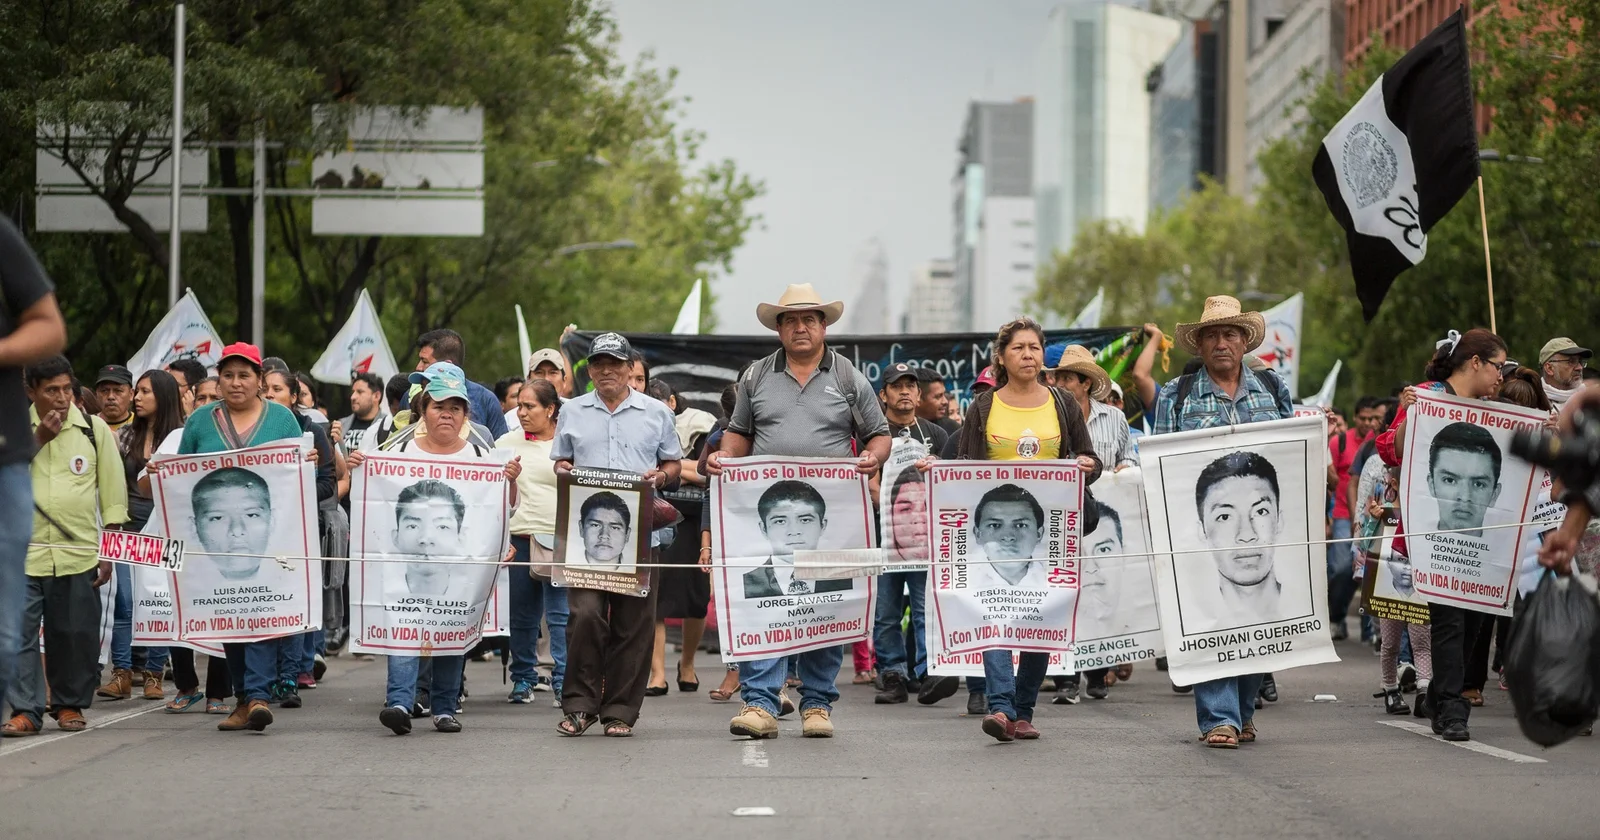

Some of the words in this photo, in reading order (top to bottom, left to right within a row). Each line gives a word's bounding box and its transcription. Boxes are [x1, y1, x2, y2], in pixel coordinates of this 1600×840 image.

[1418, 401, 1445, 418] ¡Vivo
[1449, 408, 1462, 420] se
[1466, 409, 1477, 424] lo
[162, 461, 198, 479] ¡Vivo
[201, 459, 217, 471] se
[220, 456, 233, 468] lo
[237, 451, 297, 467] llevaron!
[369, 460, 405, 476] ¡Vivo
[410, 467, 425, 477] se
[429, 465, 442, 478] lo
[446, 466, 505, 482] llevaron!
[570, 469, 609, 479] Christian
[612, 472, 641, 482] Tomás
[723, 468, 758, 483] ¡Vivo
[762, 468, 777, 480] se
[781, 466, 795, 478] lo
[800, 466, 858, 480] llevaron!
[934, 468, 972, 484] ¡Vivo
[976, 469, 992, 480] se
[996, 468, 1009, 480] lo
[1014, 468, 1077, 482] llevaron!
[577, 477, 601, 485] Colón
[602, 480, 633, 488] Garnica
[939, 509, 968, 528] 43!
[1050, 509, 1063, 538] Dónde
[1067, 511, 1078, 532] Nos
[954, 529, 967, 555] están
[1425, 534, 1455, 545] CÉSAR
[1456, 539, 1490, 551] MANUEL
[100, 532, 123, 559] NOS
[124, 535, 163, 564] FALTAN
[162, 539, 184, 569] 43!
[1066, 535, 1078, 568] faltan
[1433, 544, 1479, 559] GONZÁLEZ
[1430, 553, 1482, 568] HERNÁNDEZ
[562, 569, 582, 578] Vivos
[1430, 562, 1451, 572] EDAD
[1462, 568, 1481, 577] AÑOS
[565, 576, 585, 584] Vivos
[586, 577, 598, 585] los
[599, 579, 636, 589] queremos
[940, 567, 950, 590] Nos
[1048, 568, 1077, 589] 43!
[1429, 572, 1449, 589] VIDA
[1451, 576, 1459, 591] lo
[1460, 580, 1505, 598] queremos!
[214, 587, 236, 596] LUIS
[238, 586, 272, 594] ÁNGEL
[973, 588, 1007, 598] JESÚS
[1008, 590, 1049, 598] JOVANY
[193, 597, 250, 606] FRANCISCO
[397, 597, 433, 605] JOSÉ
[757, 599, 794, 608] JORGE
[796, 594, 844, 606] ÁLVAREZ
[981, 597, 1043, 605] RODRÍGUEZ
[1369, 598, 1387, 606] Vivos
[384, 605, 422, 613] LUNA
[426, 607, 476, 616] TORRES
[788, 607, 815, 617] NAVA
[988, 606, 1040, 614] TLATEMPA
[1371, 604, 1388, 612] Vivos
[1401, 610, 1430, 620] queremo
[185, 619, 207, 634] ¡Con
[210, 617, 234, 631] VIDA
[236, 616, 245, 630] lo
[247, 613, 303, 631] queremos!
[442, 619, 467, 627] AÑOS
[768, 621, 795, 629] EDAD
[810, 615, 835, 623] AÑOS
[1022, 614, 1044, 622] AÑOS
[1387, 612, 1405, 621] lucha
[1406, 616, 1424, 624] sigue
[147, 620, 169, 632] VIDA
[367, 625, 388, 640] ¡Con
[391, 627, 418, 640] VIDA
[421, 628, 431, 641] lo
[736, 632, 761, 648] ¡Con
[764, 629, 792, 644] VIDA
[795, 627, 803, 639] lo
[806, 618, 862, 639] queremos!
[950, 630, 972, 647] ¡Con
[974, 625, 1000, 640] VIDA
[1003, 624, 1013, 638] lo
[1015, 626, 1068, 642] queremos!
[1179, 631, 1250, 652] JHOSIVANI
[1253, 619, 1322, 641] GUERRERO
[1098, 638, 1139, 652] ÁNGEL
[1217, 651, 1235, 663] DE
[1239, 647, 1255, 659] LA
[1258, 640, 1293, 656] CRUZ
[965, 653, 984, 665] VID
[1105, 649, 1156, 663] CANTOR
